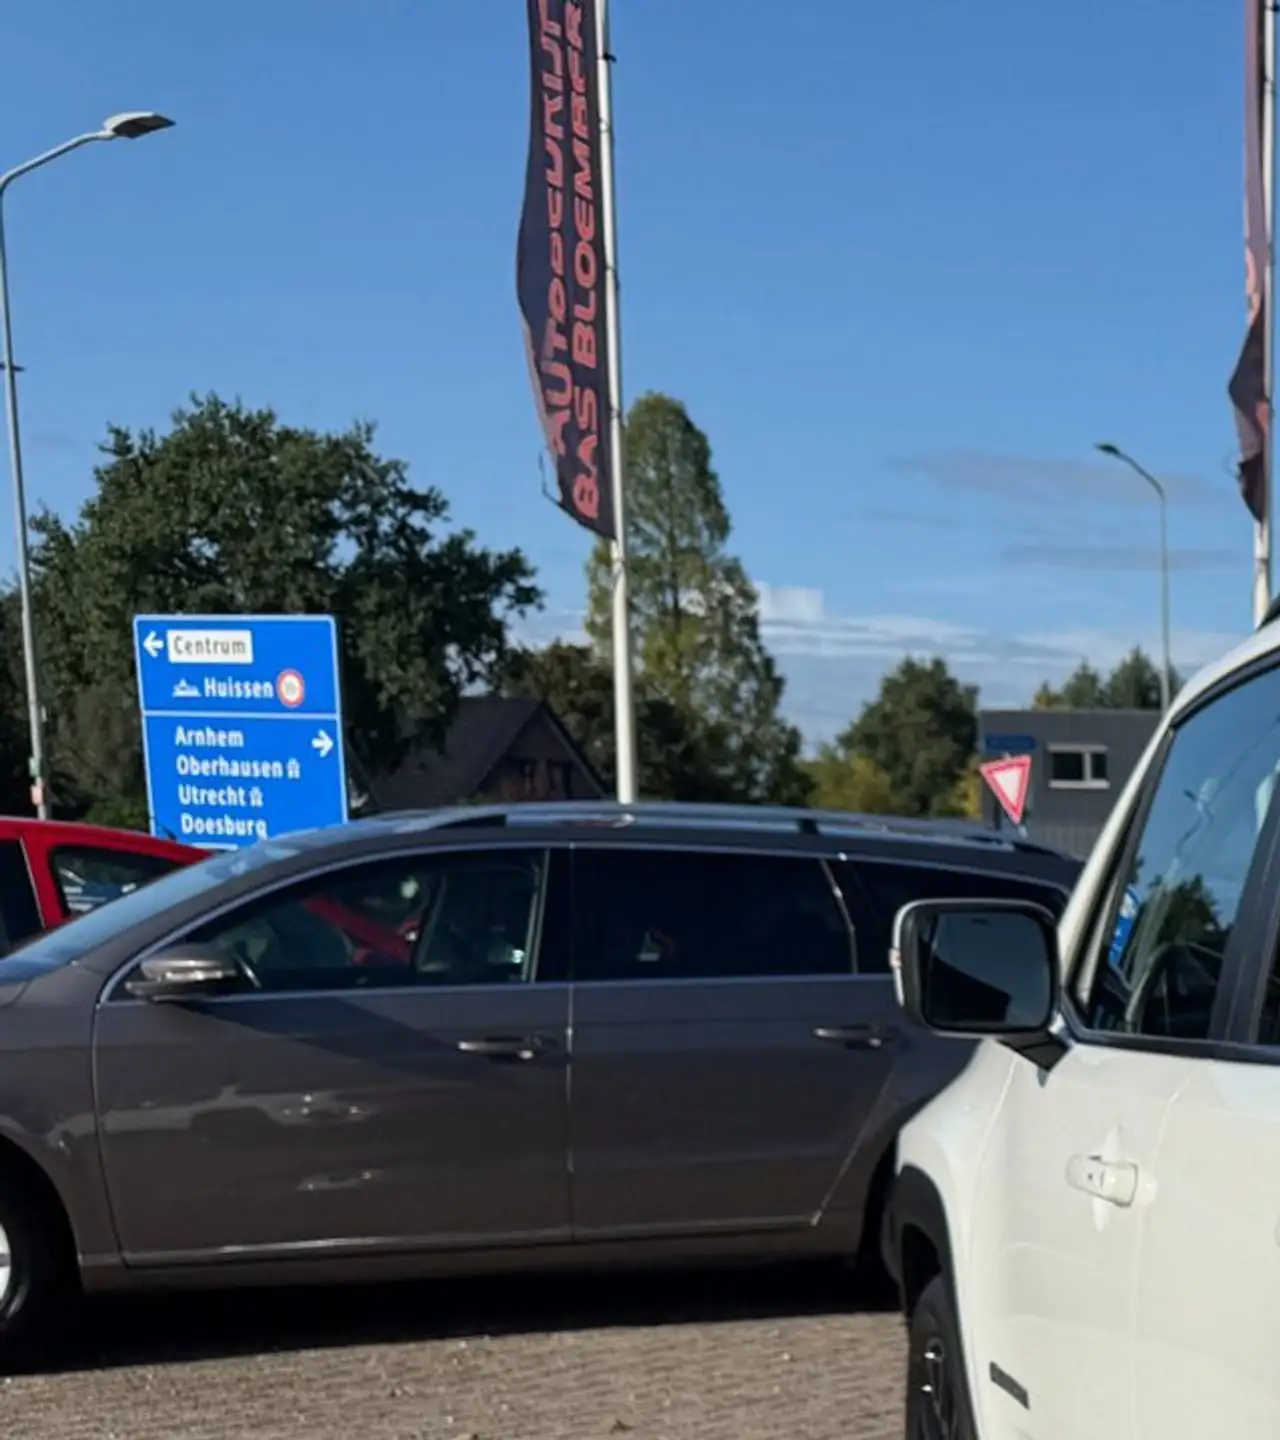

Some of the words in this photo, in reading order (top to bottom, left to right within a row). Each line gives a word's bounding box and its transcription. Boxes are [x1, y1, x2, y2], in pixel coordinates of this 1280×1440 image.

[573, 385, 598, 518] BAS
[172, 635, 247, 656] Centrum
[203, 677, 274, 698] Huissen
[175, 725, 244, 748] Arnhem
[176, 754, 283, 778] Oberhausen
[178, 783, 246, 807] Utrecht
[180, 814, 267, 840] Doesburg
